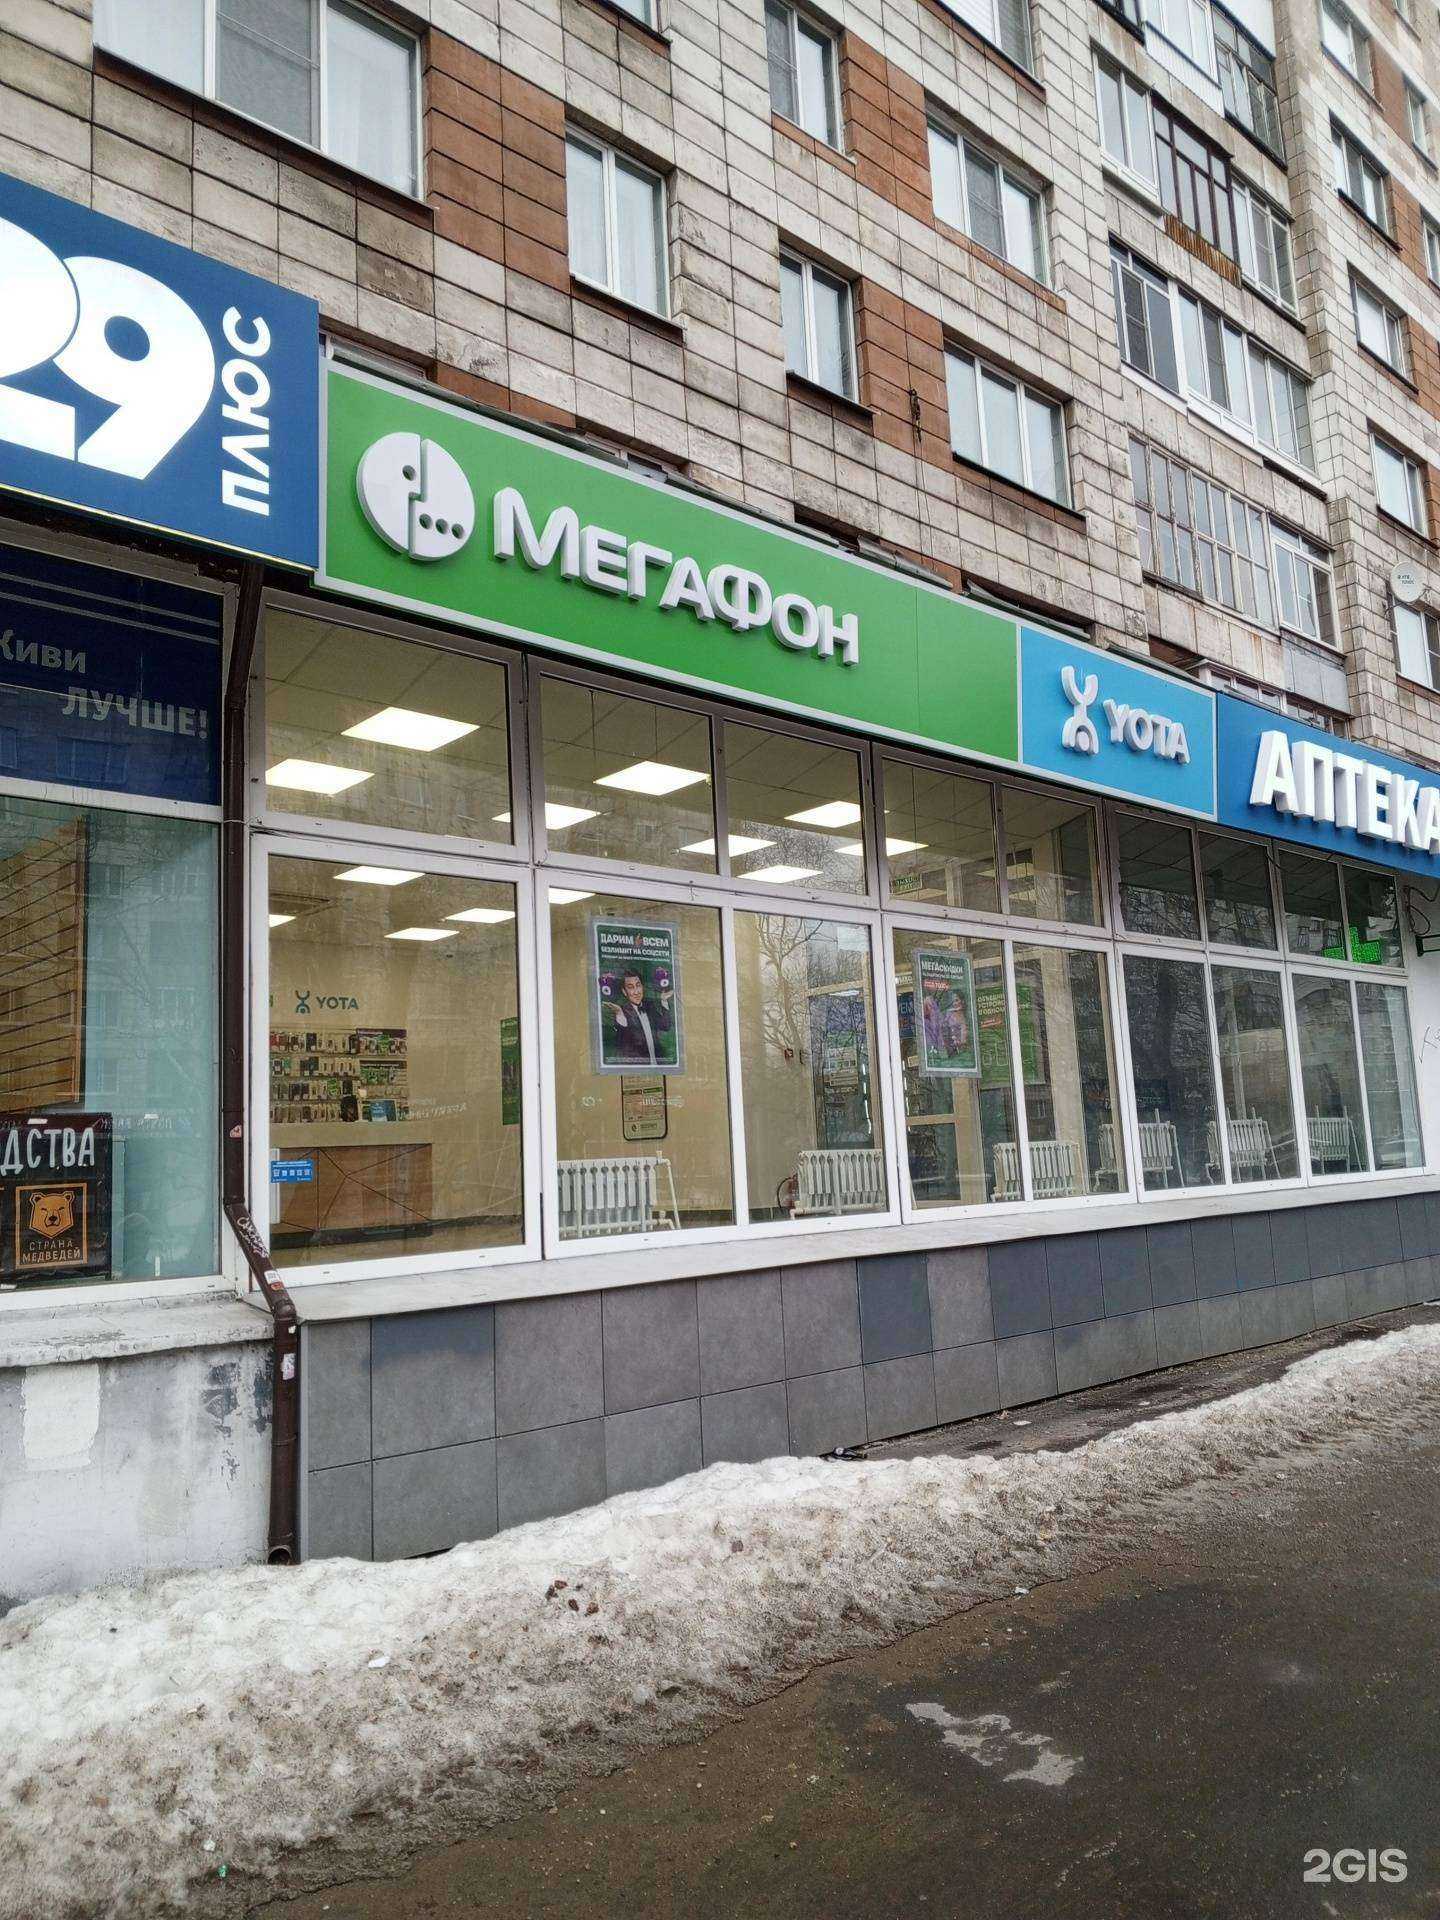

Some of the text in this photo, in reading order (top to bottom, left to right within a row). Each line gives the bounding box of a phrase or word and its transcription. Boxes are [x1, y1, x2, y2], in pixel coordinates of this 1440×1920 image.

[222, 306, 272, 517] ПЛЮС
[493, 486, 859, 666] МЕГАФОН
[61, 686, 208, 739] ЛУЧШЕ!
[1103, 699, 1191, 765] YOTA
[1249, 730, 1440, 855] АПТЕКА
[600, 933, 669, 948] ДАРИМ ВСЕМ
[316, 996, 360, 1010] YOTA
[22, 1249, 81, 1263] МЕДВЕДЕЙ
[29, 1239, 74, 1251] СТРАНА
